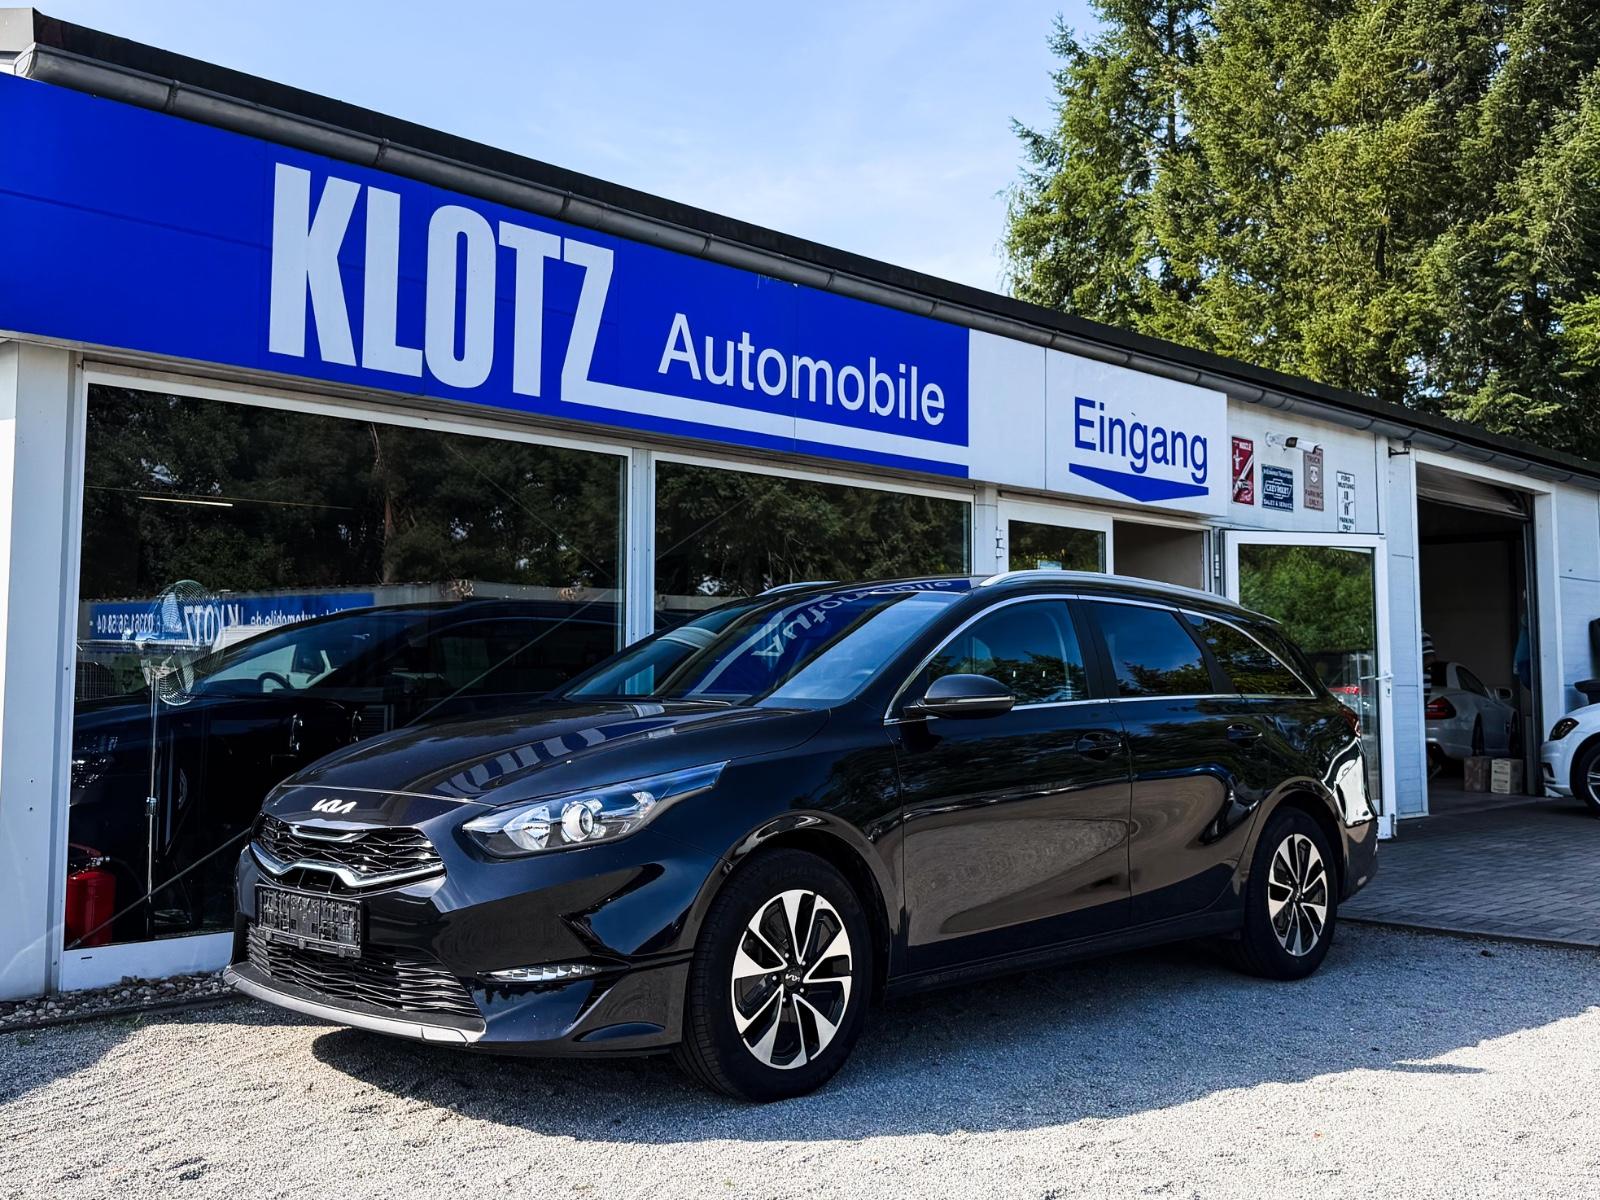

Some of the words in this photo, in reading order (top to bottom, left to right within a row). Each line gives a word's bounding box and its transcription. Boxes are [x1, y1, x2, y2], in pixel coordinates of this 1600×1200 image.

[269, 162, 614, 402] KLOTZ
[657, 312, 946, 427] Automobile
[1074, 396, 1208, 485] Eingang
